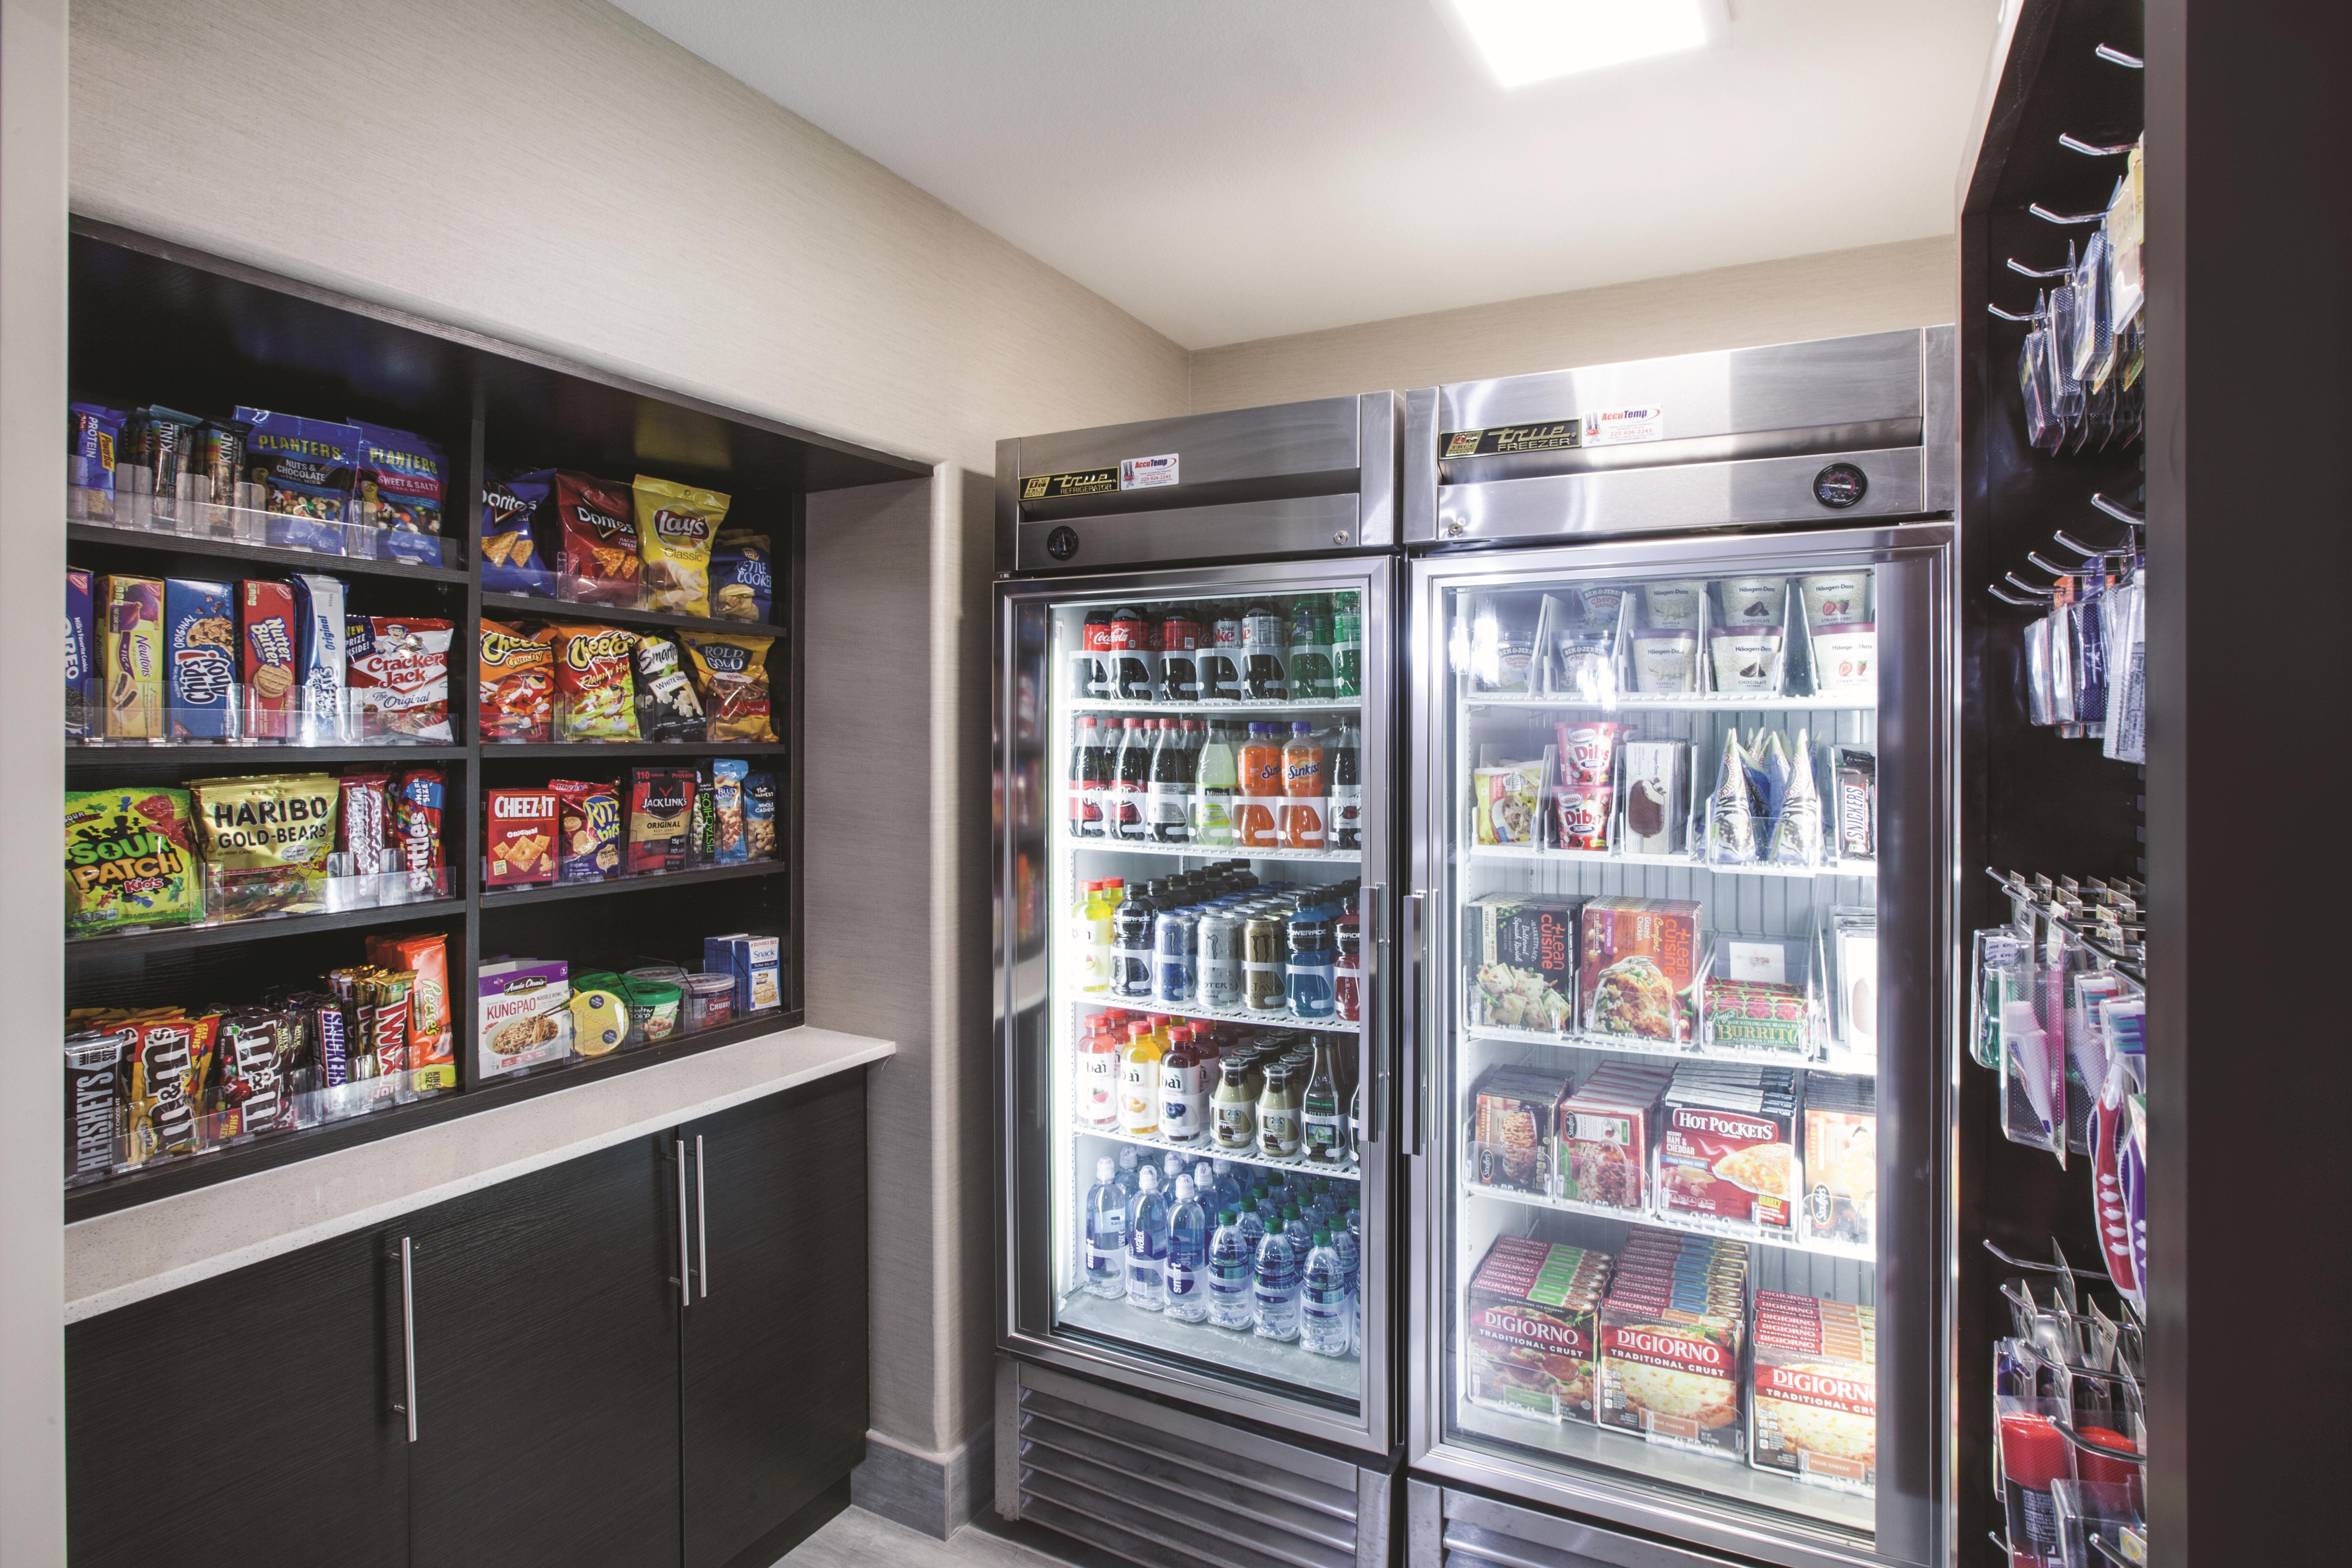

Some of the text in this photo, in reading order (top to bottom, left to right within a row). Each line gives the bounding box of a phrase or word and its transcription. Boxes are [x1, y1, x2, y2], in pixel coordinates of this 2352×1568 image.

[1602, 410, 1647, 421] AccuTemp
[87, 417, 98, 458] PROTEIN
[160, 422, 173, 452] KIND
[1497, 438, 1570, 452] FREEZER
[220, 432, 233, 464] KIND
[258, 435, 341, 461] PLANTERS
[285, 459, 307, 469] NUTS
[369, 448, 438, 474] PLANTERS
[1135, 459, 1167, 468] AccuTemp
[277, 465, 326, 482] CHOCOLATE
[379, 475, 406, 486] SWEET
[414, 481, 438, 492] SALTY
[1060, 483, 1111, 494] REFRIGERATOR
[664, 548, 702, 562] Classic
[74, 617, 82, 635] Milk's
[173, 615, 197, 648] ORIGINAL
[77, 633, 86, 653] Favorite
[250, 624, 279, 667] Butter
[265, 617, 292, 662] Nutter
[134, 635, 152, 678] Newtons
[367, 653, 443, 672] Cracker
[506, 650, 543, 668] Crunchy
[707, 657, 743, 670] GOLD
[378, 669, 426, 689] Jack
[384, 691, 430, 708] Original
[1287, 762, 1321, 780] Sunkist
[214, 797, 328, 828] HARIBO
[642, 798, 664, 808] JACK
[702, 792, 715, 853] PISTACHIOS
[1846, 787, 1864, 841] SNICKERS
[218, 823, 328, 849] GOLD-BEARS
[71, 833, 170, 864] SOUR
[71, 853, 181, 889] PATCH
[753, 949, 775, 958] Snack
[77, 1072, 114, 1172] HERSHEY'S
[1679, 1112, 1773, 1140] HOT POCKETS
[1666, 1136, 1680, 1145] HAM
[1666, 1144, 1695, 1155] CHEDDAR
[1479, 1328, 1583, 1357] TRADITIONAL CRUST
[1611, 1349, 1725, 1377] TRADITIONAL CRUST
[1766, 1388, 1849, 1411] TRADITIONAL
[1824, 1462, 1850, 1472] CHEESE
